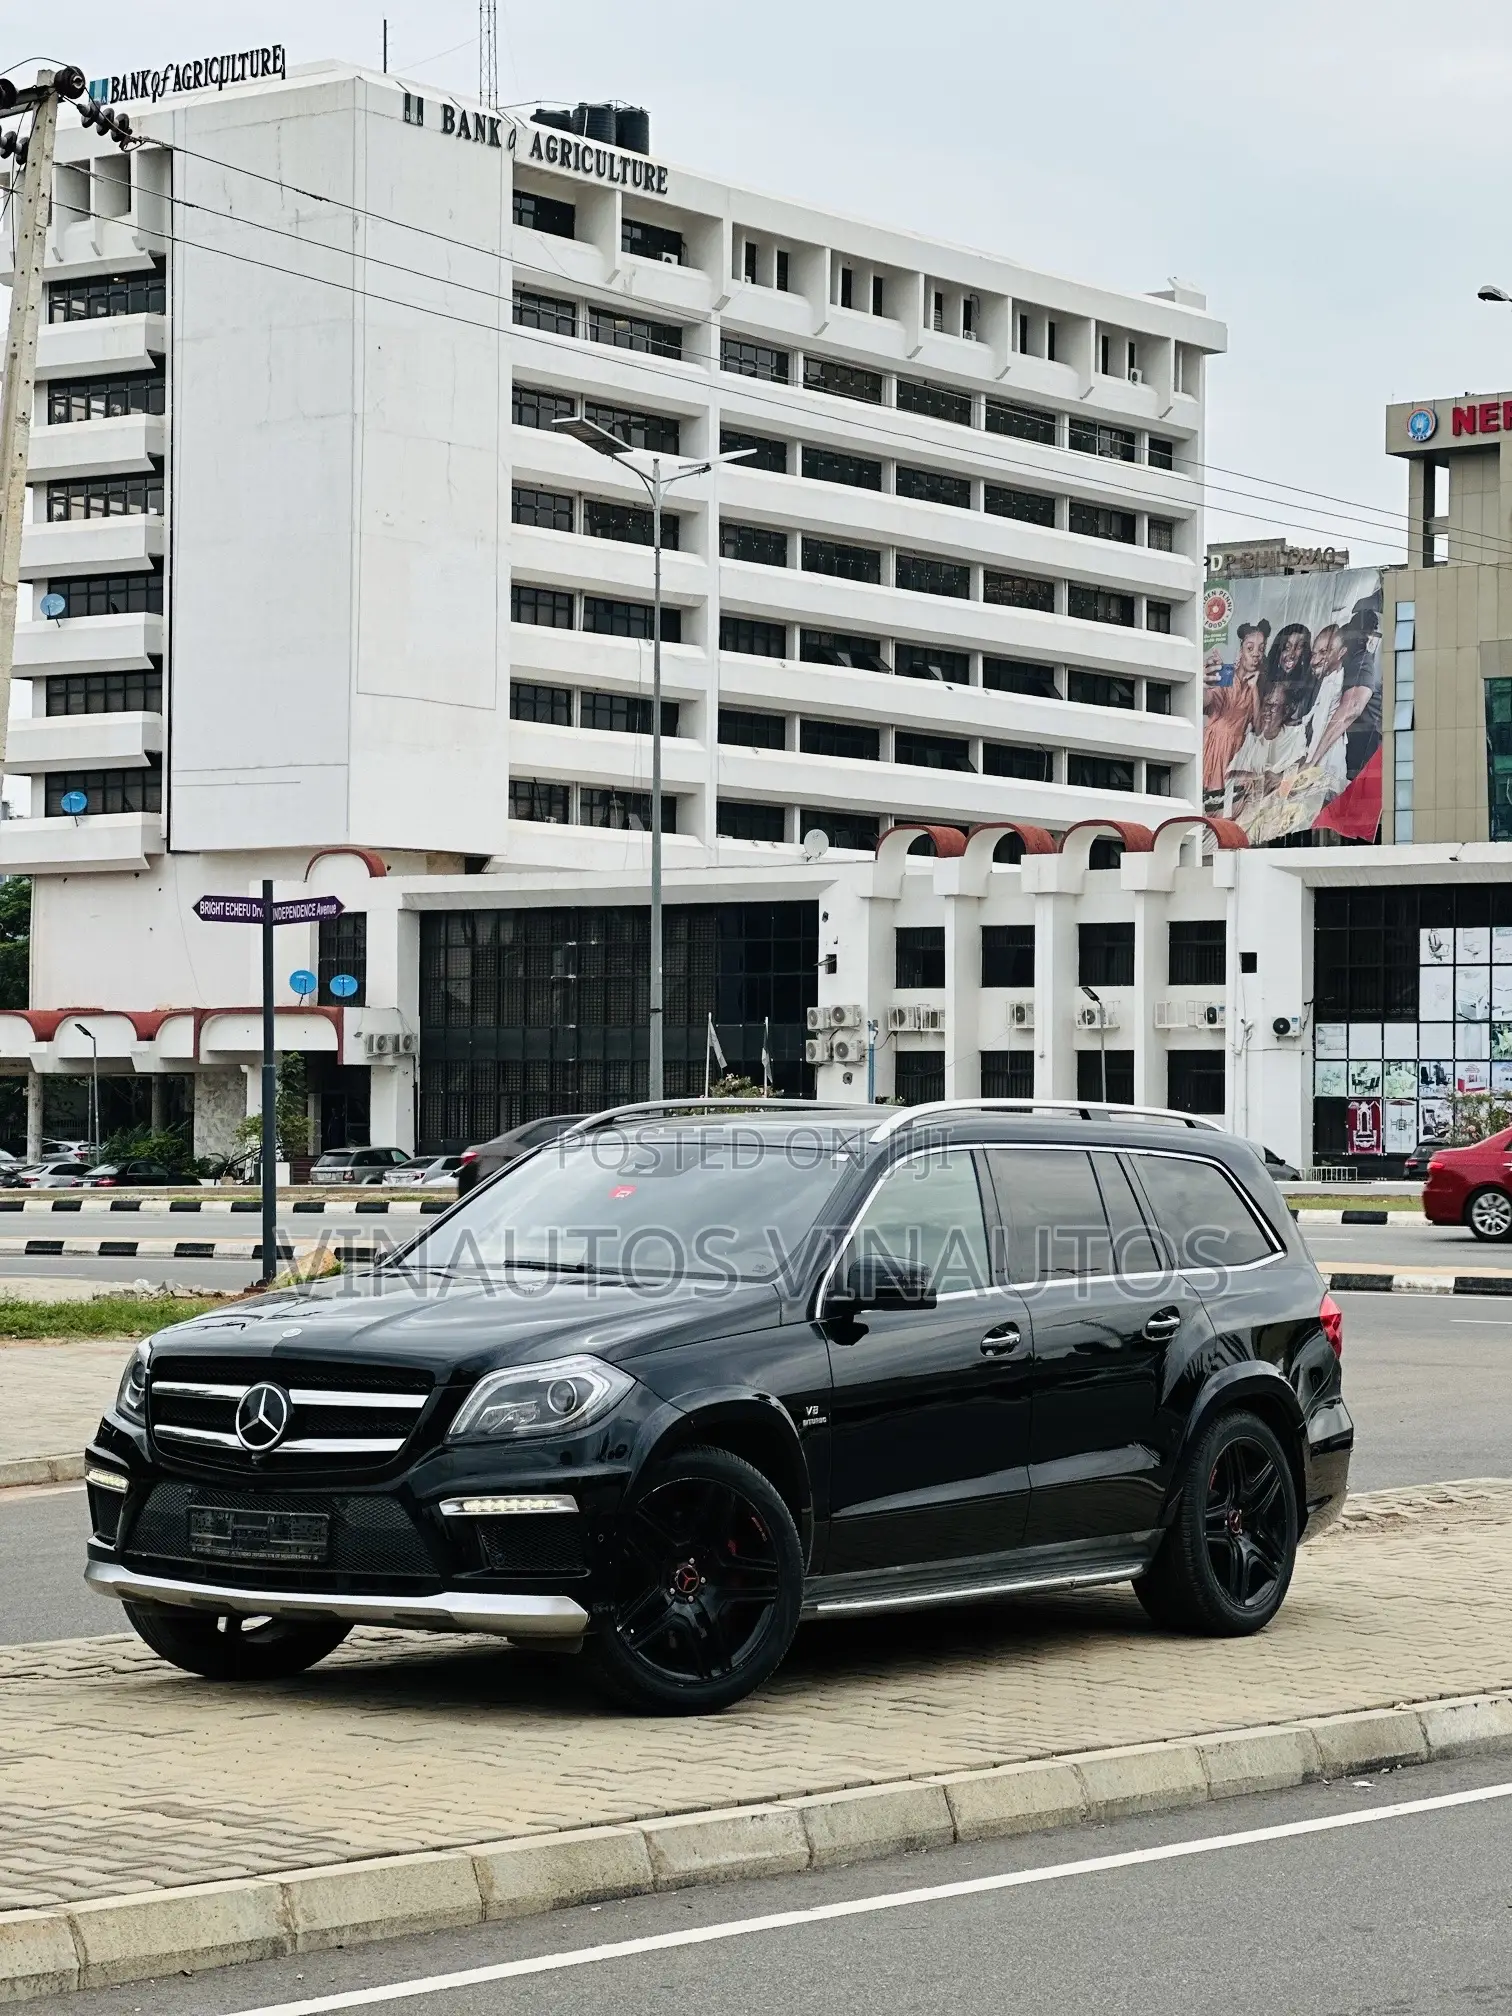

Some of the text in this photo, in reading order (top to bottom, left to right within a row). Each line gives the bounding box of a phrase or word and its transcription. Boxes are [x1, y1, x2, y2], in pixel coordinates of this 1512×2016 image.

[110, 69, 152, 103] BANK
[172, 44, 283, 92] AGRICULTURE
[440, 103, 502, 148] BANK
[529, 131, 668, 195] AGRICULTURE
[1219, 590, 1233, 612] PENNY
[1204, 619, 1227, 629] FOODS
[200, 900, 225, 915] BRIGHT
[225, 901, 250, 917] ECHEFU
[272, 902, 337, 921] INDEPENDENCE Avenue
[805, 1405, 819, 1416] V8
